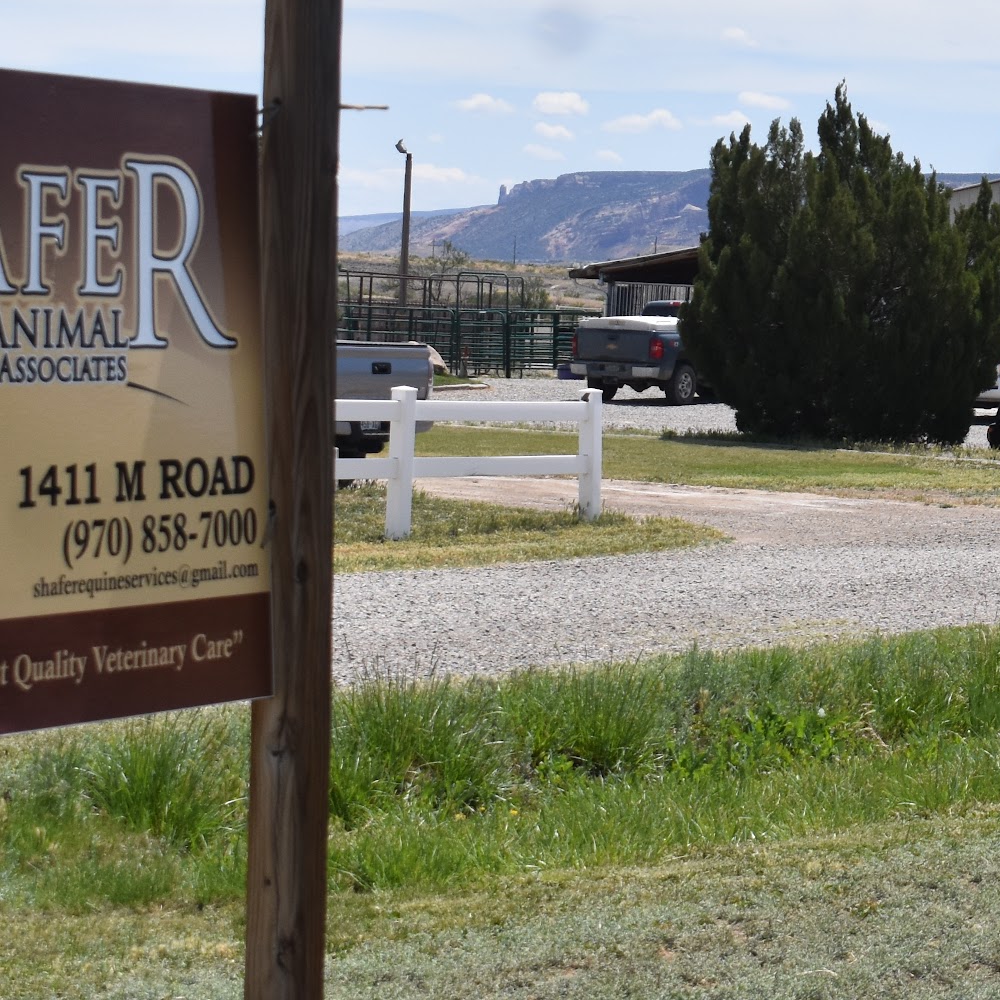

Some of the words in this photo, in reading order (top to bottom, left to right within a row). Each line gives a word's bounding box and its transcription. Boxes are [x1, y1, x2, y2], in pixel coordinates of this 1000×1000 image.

[0, 158, 238, 349] FER
[0, 353, 127, 382] ASSOCIATES
[19, 462, 101, 508] 1411
[115, 460, 146, 503] M
[159, 455, 255, 499] ROAD
[63, 516, 133, 569] (970)
[142, 507, 257, 553] 858-7000
[33, 561, 259, 598] shaferequineservices@gmail.com
[13, 650, 87, 690] Quality
[93, 640, 187, 673] Veterinary
